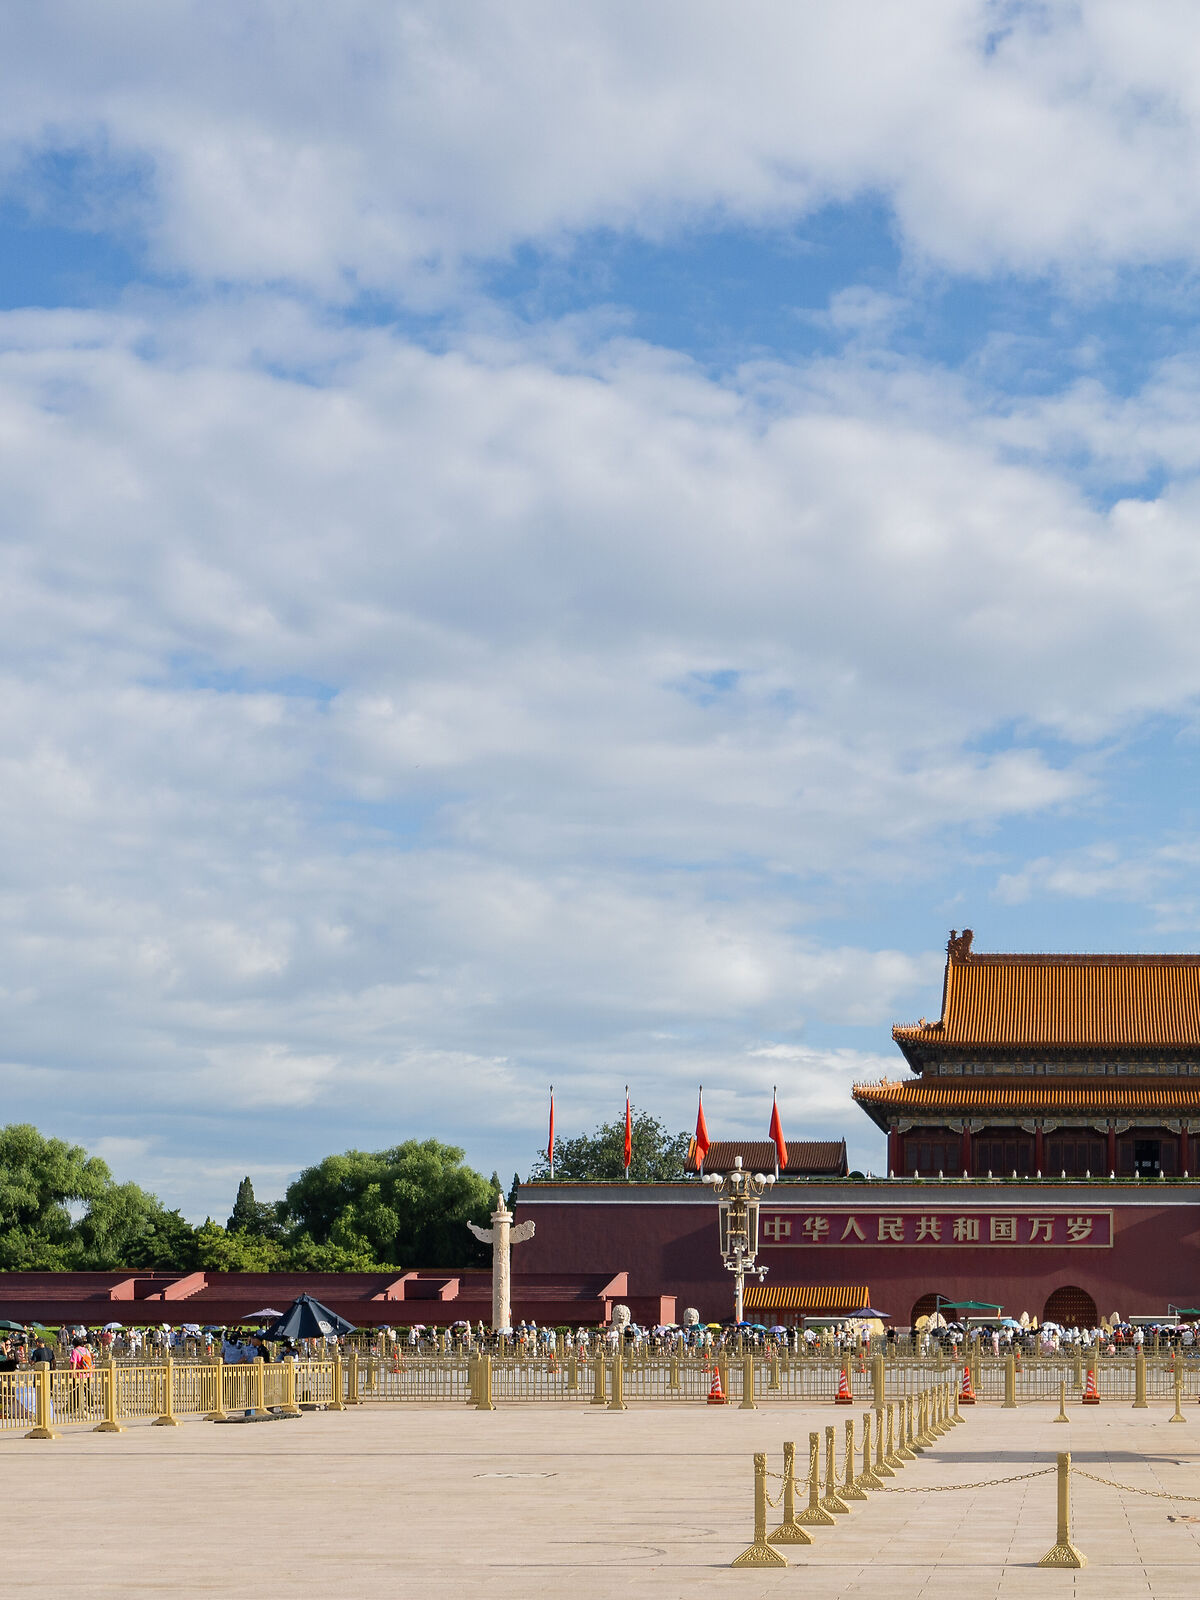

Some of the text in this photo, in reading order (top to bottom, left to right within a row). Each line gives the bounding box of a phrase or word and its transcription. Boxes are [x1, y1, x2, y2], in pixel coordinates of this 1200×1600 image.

[763, 1216, 1094, 1241] 中华人民共和国万岁
